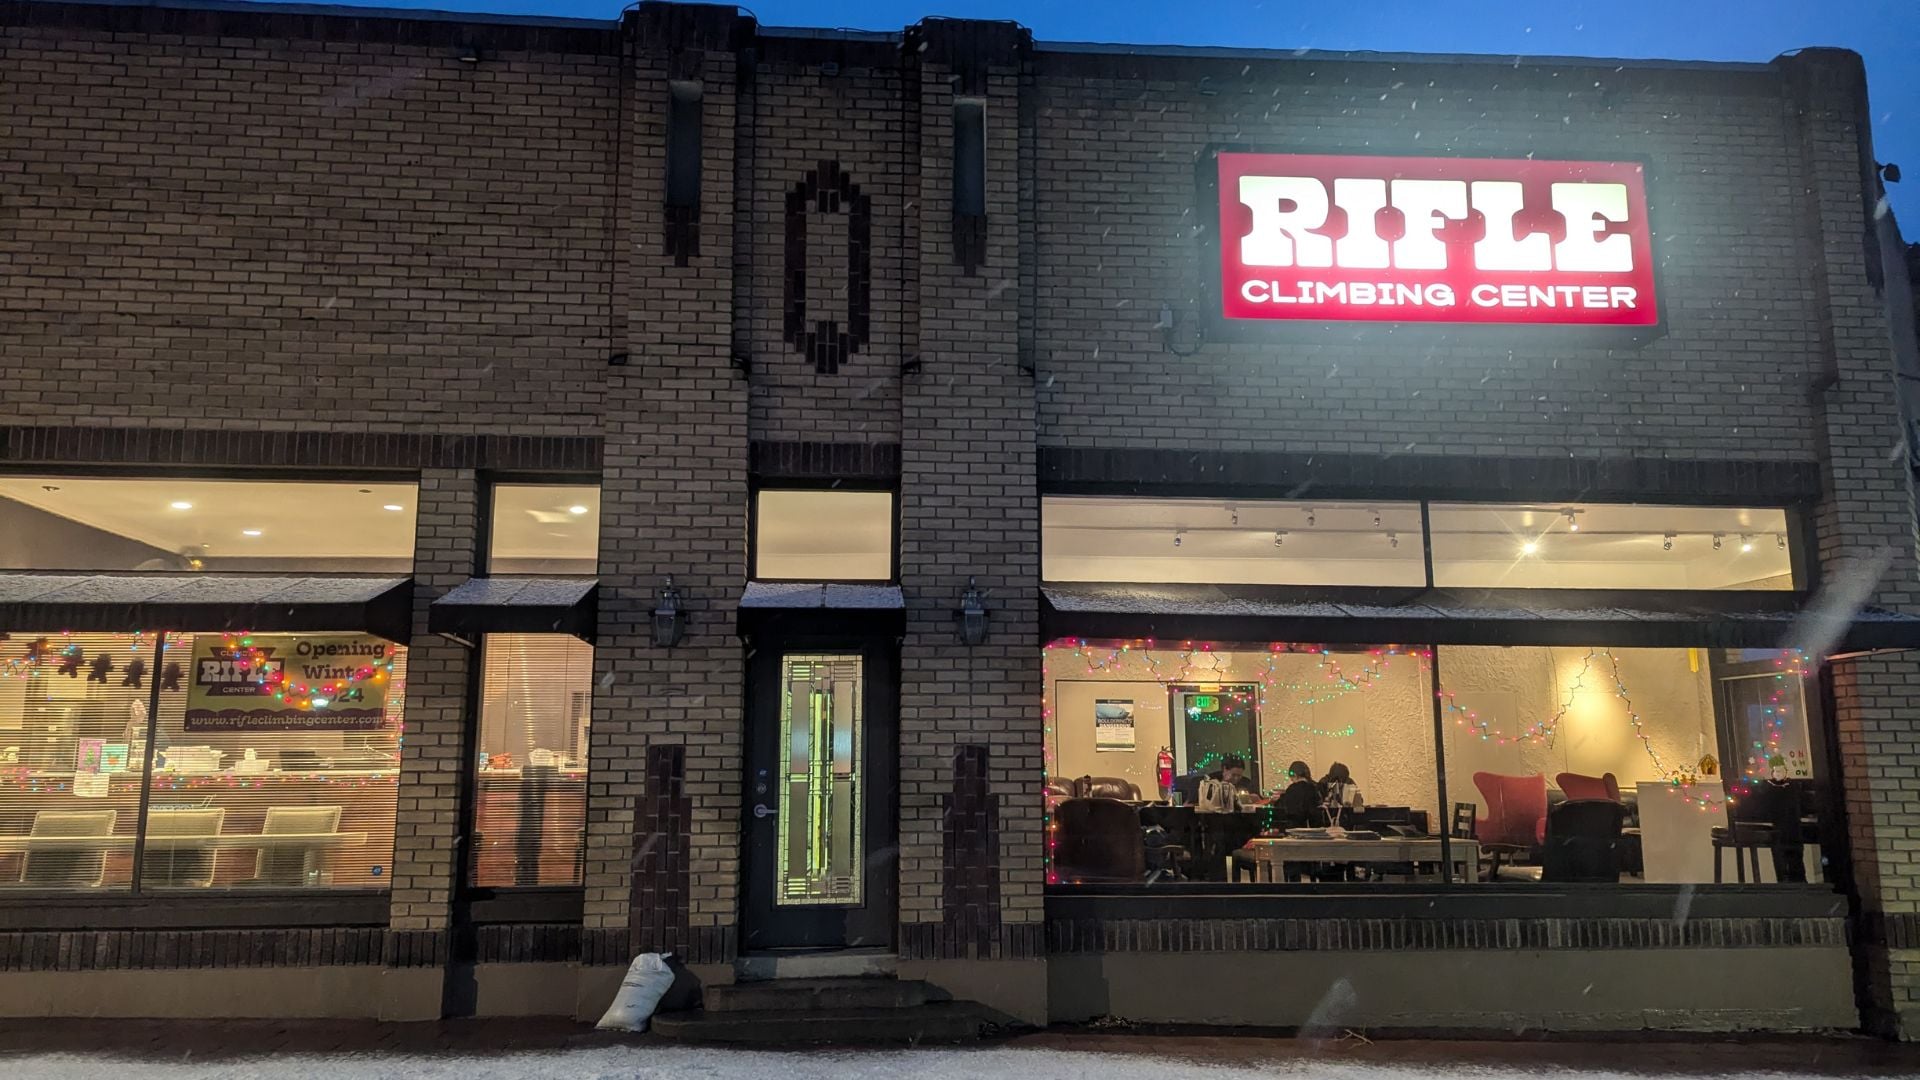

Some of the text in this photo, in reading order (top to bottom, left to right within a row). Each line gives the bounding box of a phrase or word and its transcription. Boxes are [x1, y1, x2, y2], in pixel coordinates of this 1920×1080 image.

[1239, 176, 1634, 273] RIFLE
[1241, 279, 1638, 309] CLIMBING CENTER
[296, 641, 385, 659] Opening
[201, 661, 281, 682] RIFLE
[191, 713, 384, 728] www.rifleclimbingcenter.com
